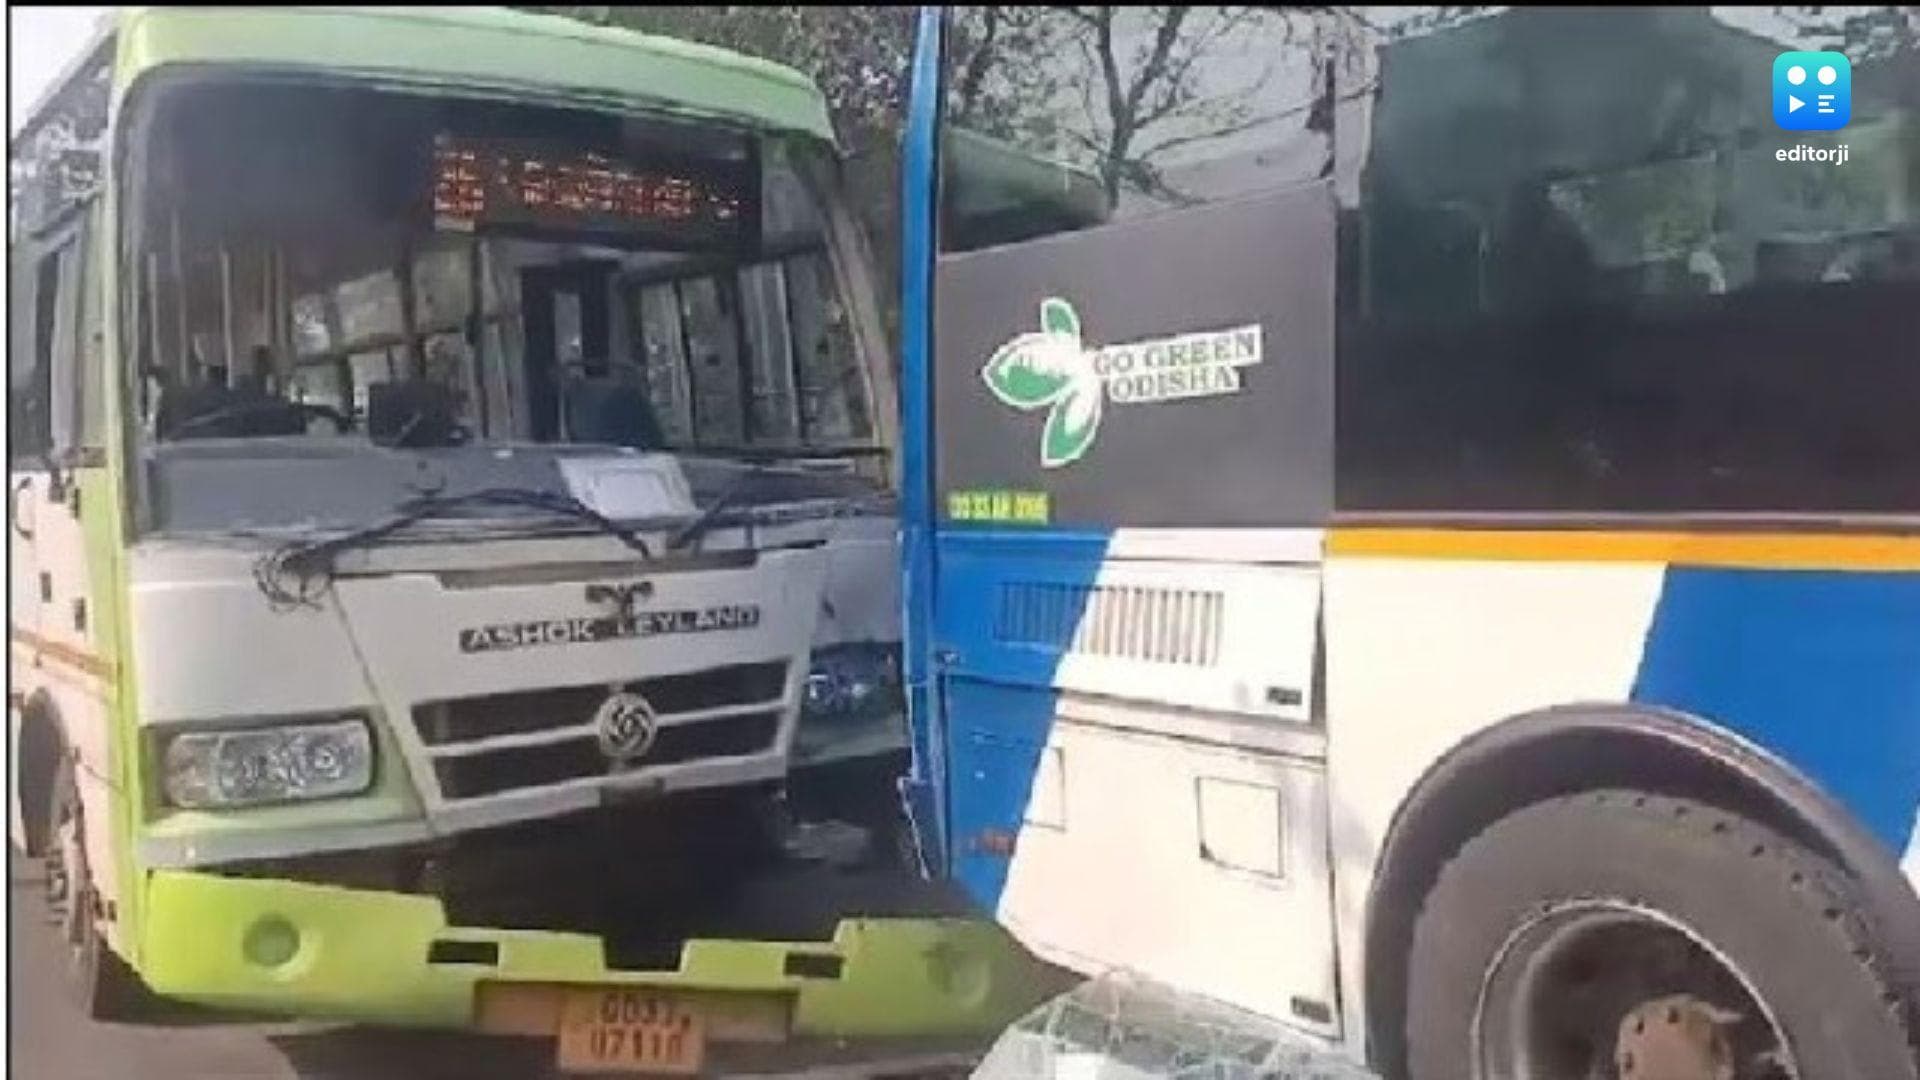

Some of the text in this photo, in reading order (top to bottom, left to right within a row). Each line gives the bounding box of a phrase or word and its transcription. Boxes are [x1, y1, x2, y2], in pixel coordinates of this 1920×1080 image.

[1094, 331, 1256, 377] GO GREEN
[1112, 364, 1235, 400] ODISHA
[462, 606, 759, 651] ASHOK LEYLAND
